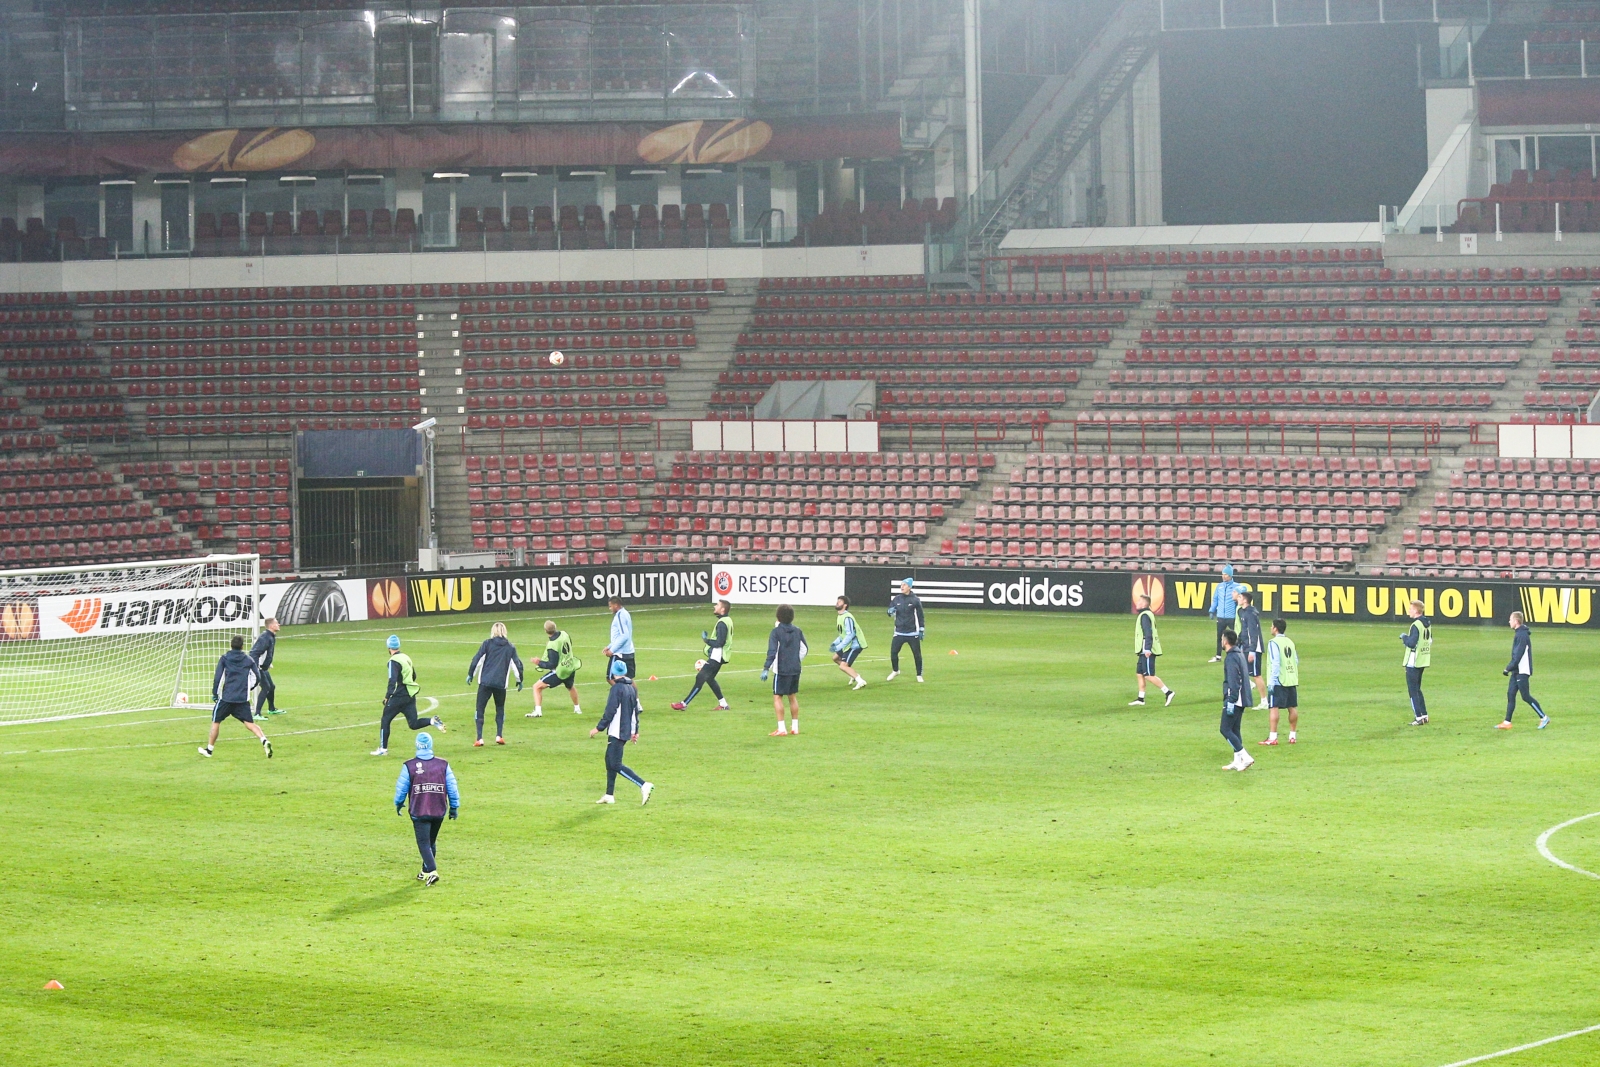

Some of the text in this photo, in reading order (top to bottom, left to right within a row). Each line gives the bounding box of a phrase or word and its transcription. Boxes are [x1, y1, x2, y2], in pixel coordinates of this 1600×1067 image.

[421, 576, 472, 611] WU
[482, 571, 709, 605] BUSINESS SOLUTIONS
[738, 575, 810, 594] RESPECT
[988, 577, 1083, 606] adidas
[1175, 581, 1494, 618] WTERN UNION
[1529, 586, 1592, 624] WU
